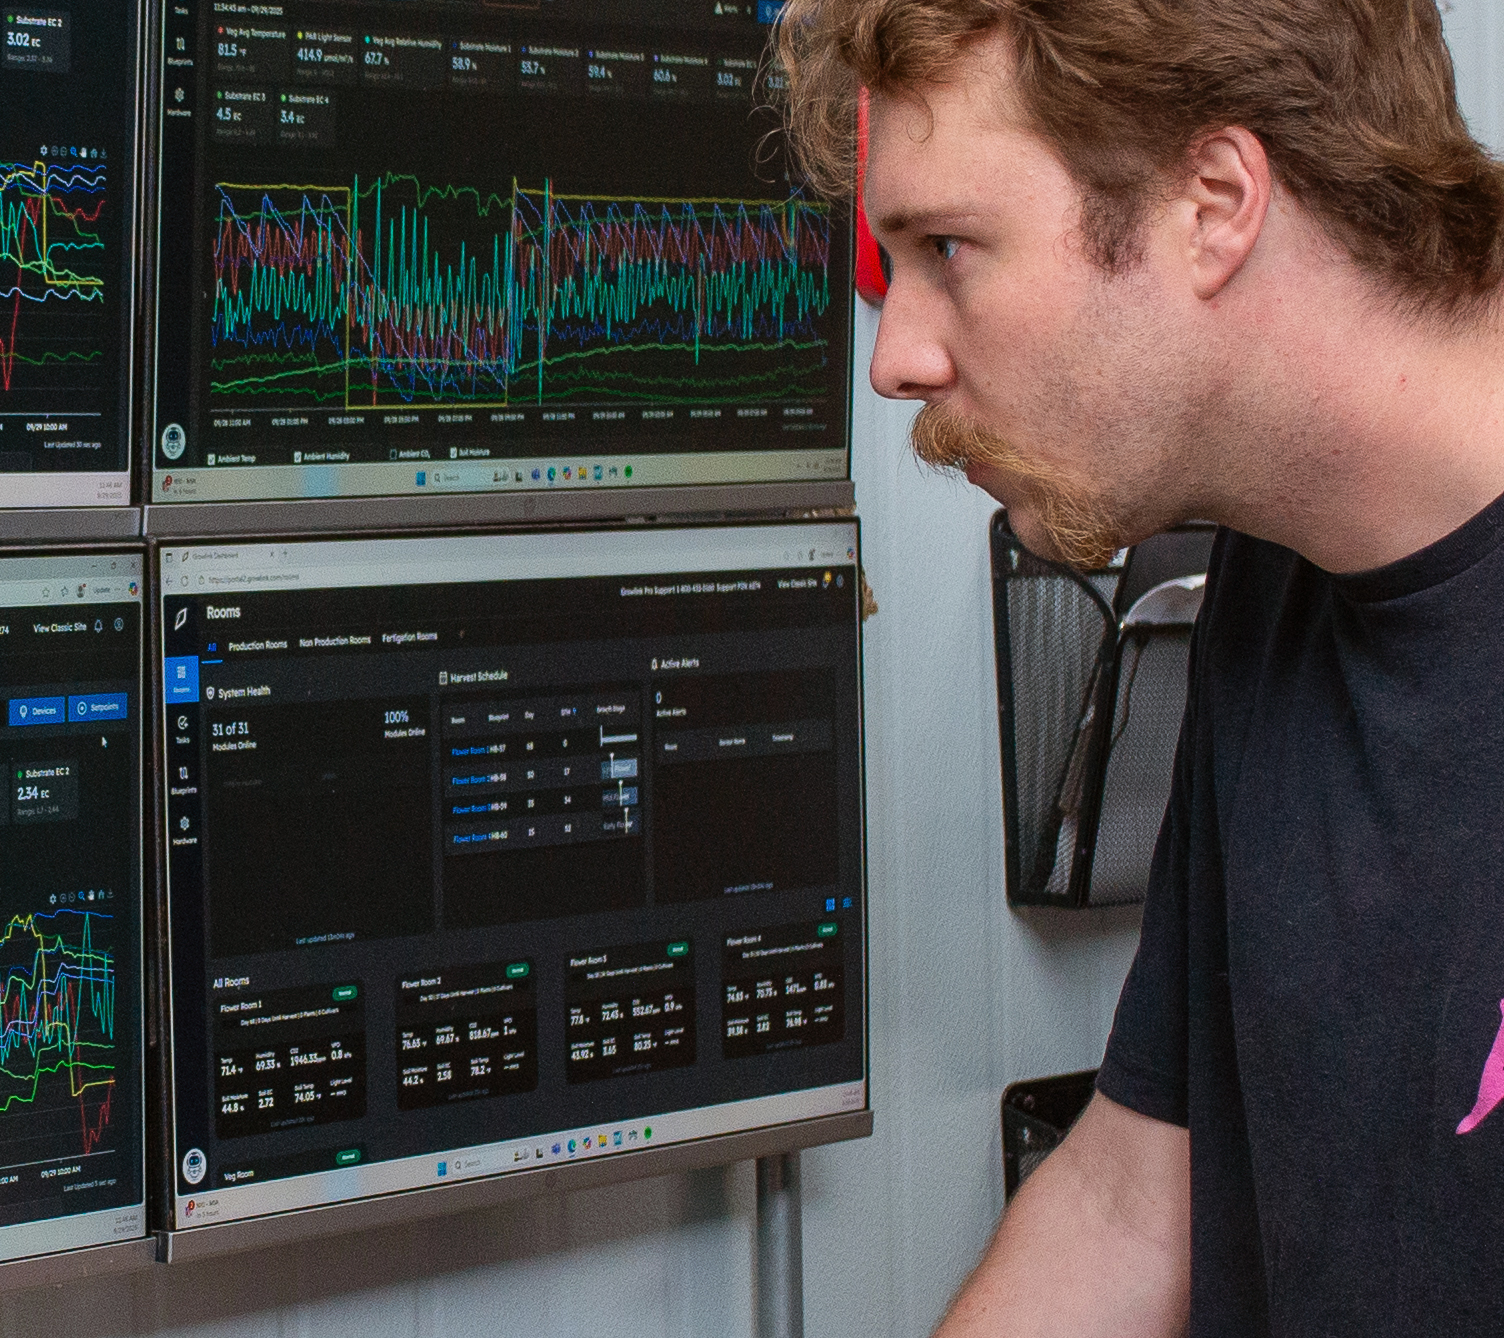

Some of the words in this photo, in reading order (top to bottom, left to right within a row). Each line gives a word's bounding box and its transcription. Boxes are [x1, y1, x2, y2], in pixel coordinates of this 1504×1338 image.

[207, 605, 241, 619] Rooms
[385, 710, 409, 724] 100%
[212, 723, 223, 736] 31
[225, 722, 236, 735] of
[238, 722, 249, 734] 31
